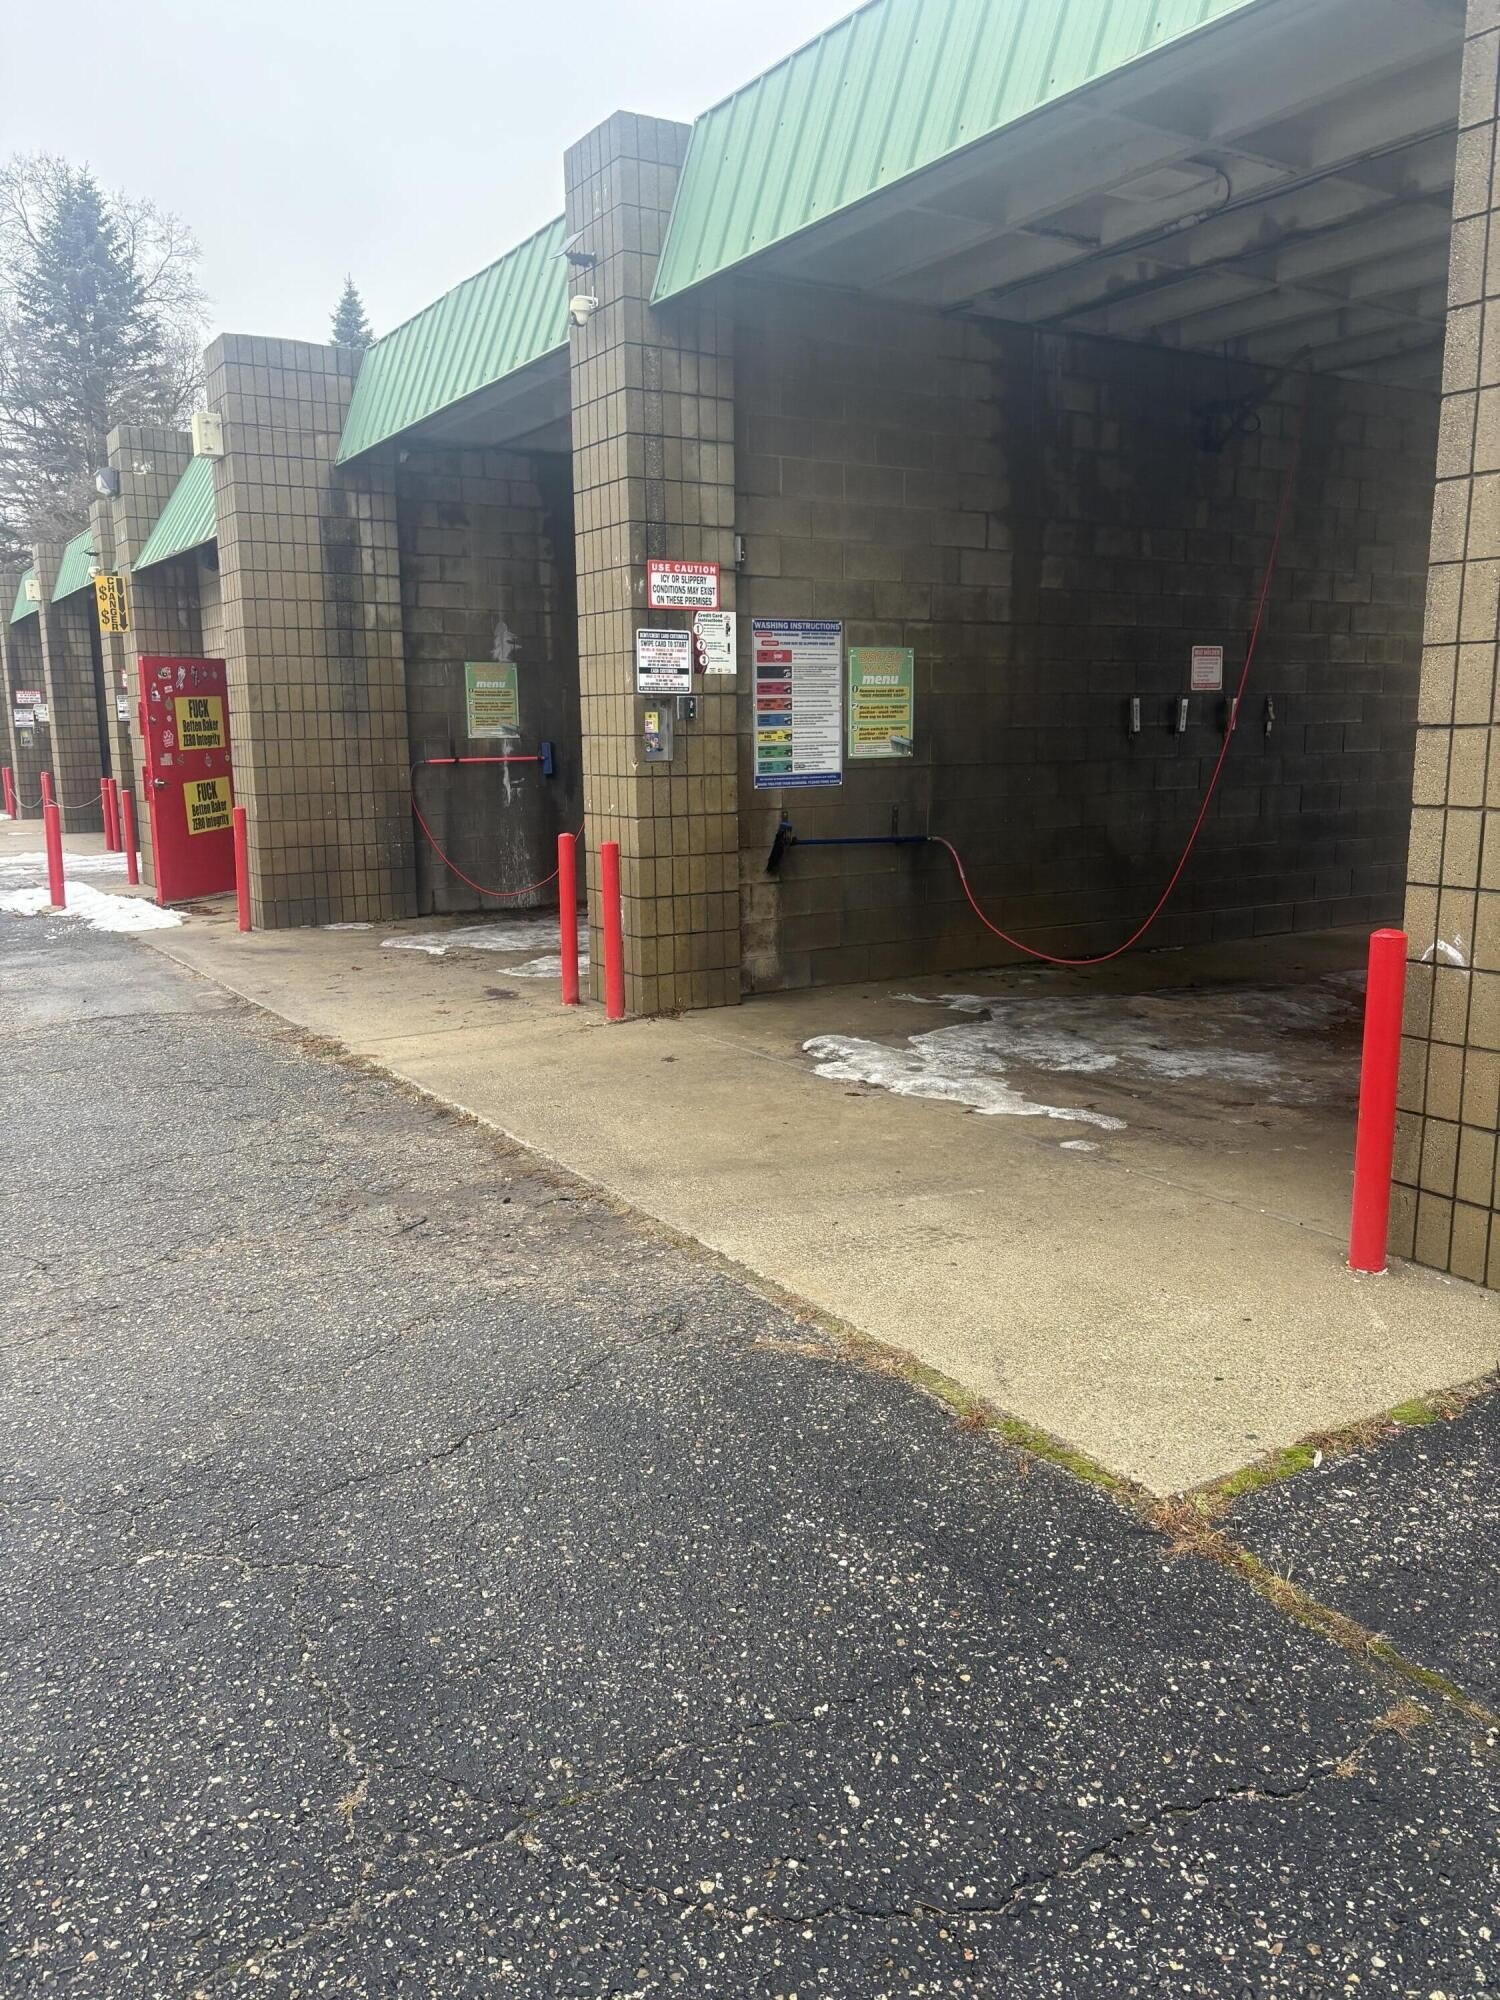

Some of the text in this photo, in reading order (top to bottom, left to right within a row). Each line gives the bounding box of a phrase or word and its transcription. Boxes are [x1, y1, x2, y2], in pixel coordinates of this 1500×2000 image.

[651, 563, 716, 574] USE CAUTION
[681, 576, 707, 584] SLIPPERY
[653, 585, 716, 596] CONDITIONS MAY EXIST
[106, 576, 119, 631] CHANGER
[656, 596, 712, 606] ON THESE PREMISES
[754, 622, 840, 630] WASHING INSTRUCTIONS
[862, 675, 899, 684] menu
[188, 699, 210, 718] FUCK
[183, 719, 218, 732] Betten Baker
[183, 732, 220, 747] ZERO Integrity
[197, 781, 218, 802] FUCK
[192, 800, 227, 816] Betten Baker
[192, 814, 229, 830] ZERO Integrity
